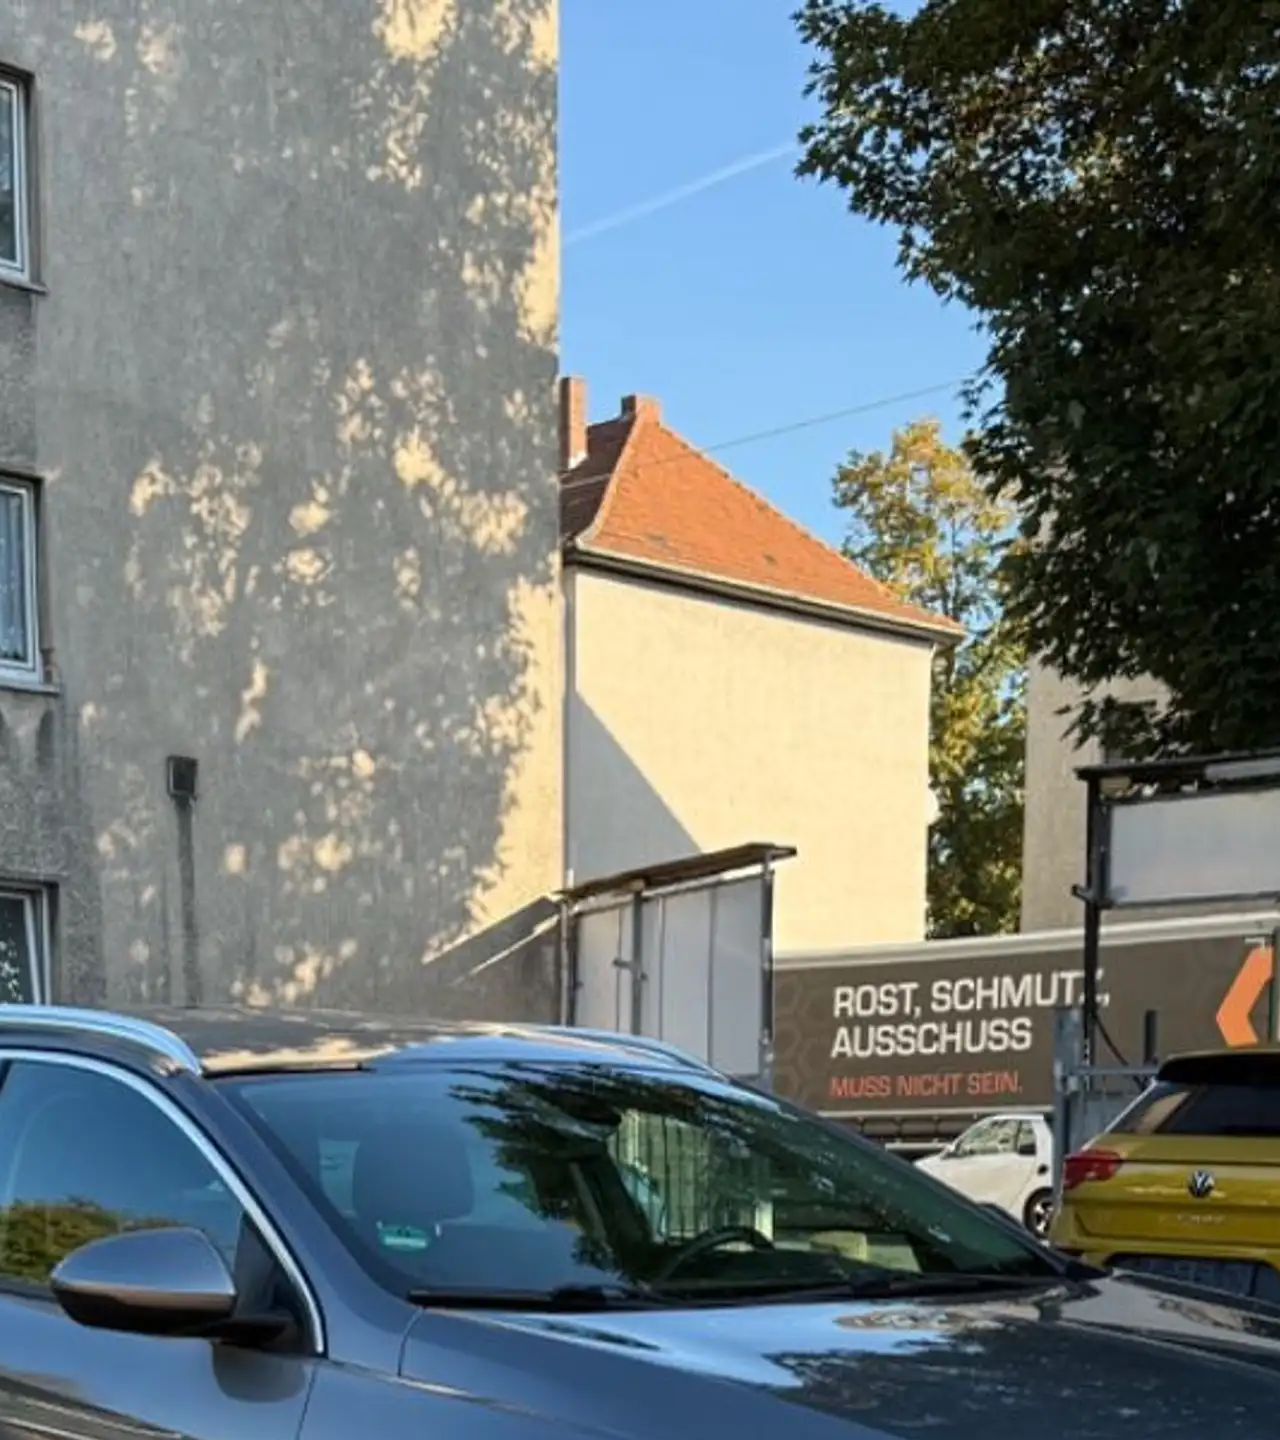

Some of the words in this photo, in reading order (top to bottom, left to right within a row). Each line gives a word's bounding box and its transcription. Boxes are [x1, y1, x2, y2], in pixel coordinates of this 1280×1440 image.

[833, 982, 921, 1019] ROST,
[830, 1017, 1033, 1059] AUSSCHUSS
[830, 1075, 892, 1098] MUSS
[896, 1073, 962, 1097] NICHT
[966, 1070, 1023, 1095] SEIN.
